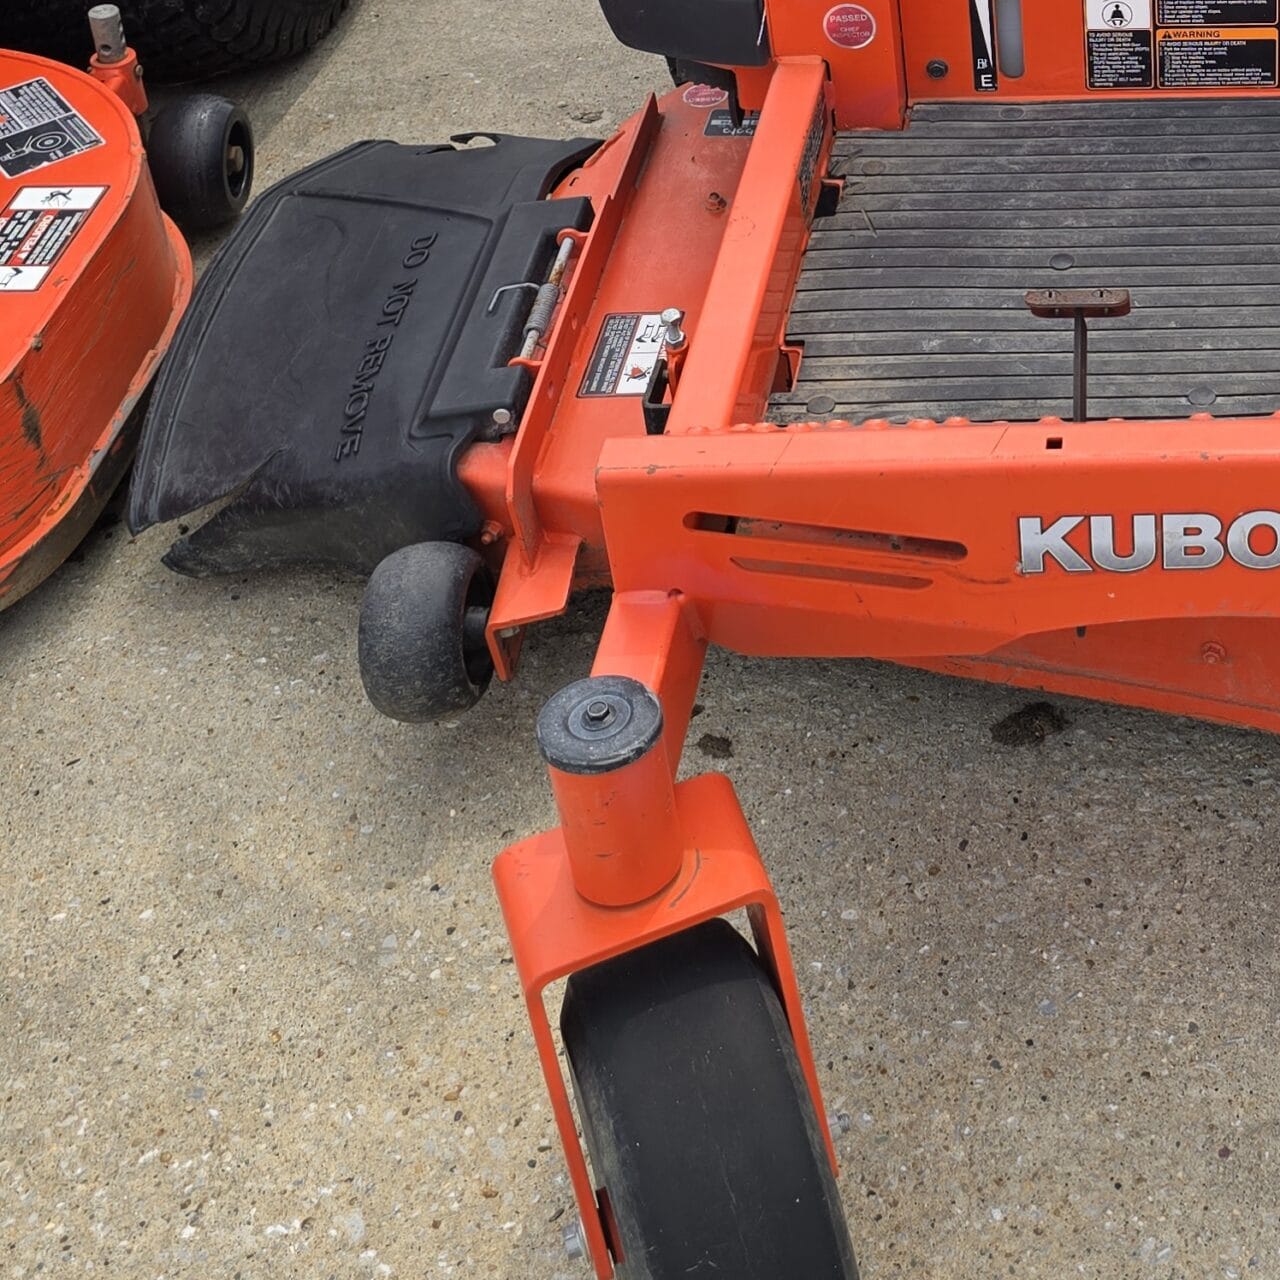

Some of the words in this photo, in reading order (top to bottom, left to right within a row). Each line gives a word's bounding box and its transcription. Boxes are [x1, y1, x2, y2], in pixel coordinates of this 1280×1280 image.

[830, 14, 867, 22] PASSED
[1172, 30, 1220, 38] WARNING
[981, 75, 993, 87] E
[21, 215, 54, 251] PELIGRO
[403, 232, 438, 269] DO
[377, 278, 418, 327] NOT
[334, 334, 394, 462] REMOVE
